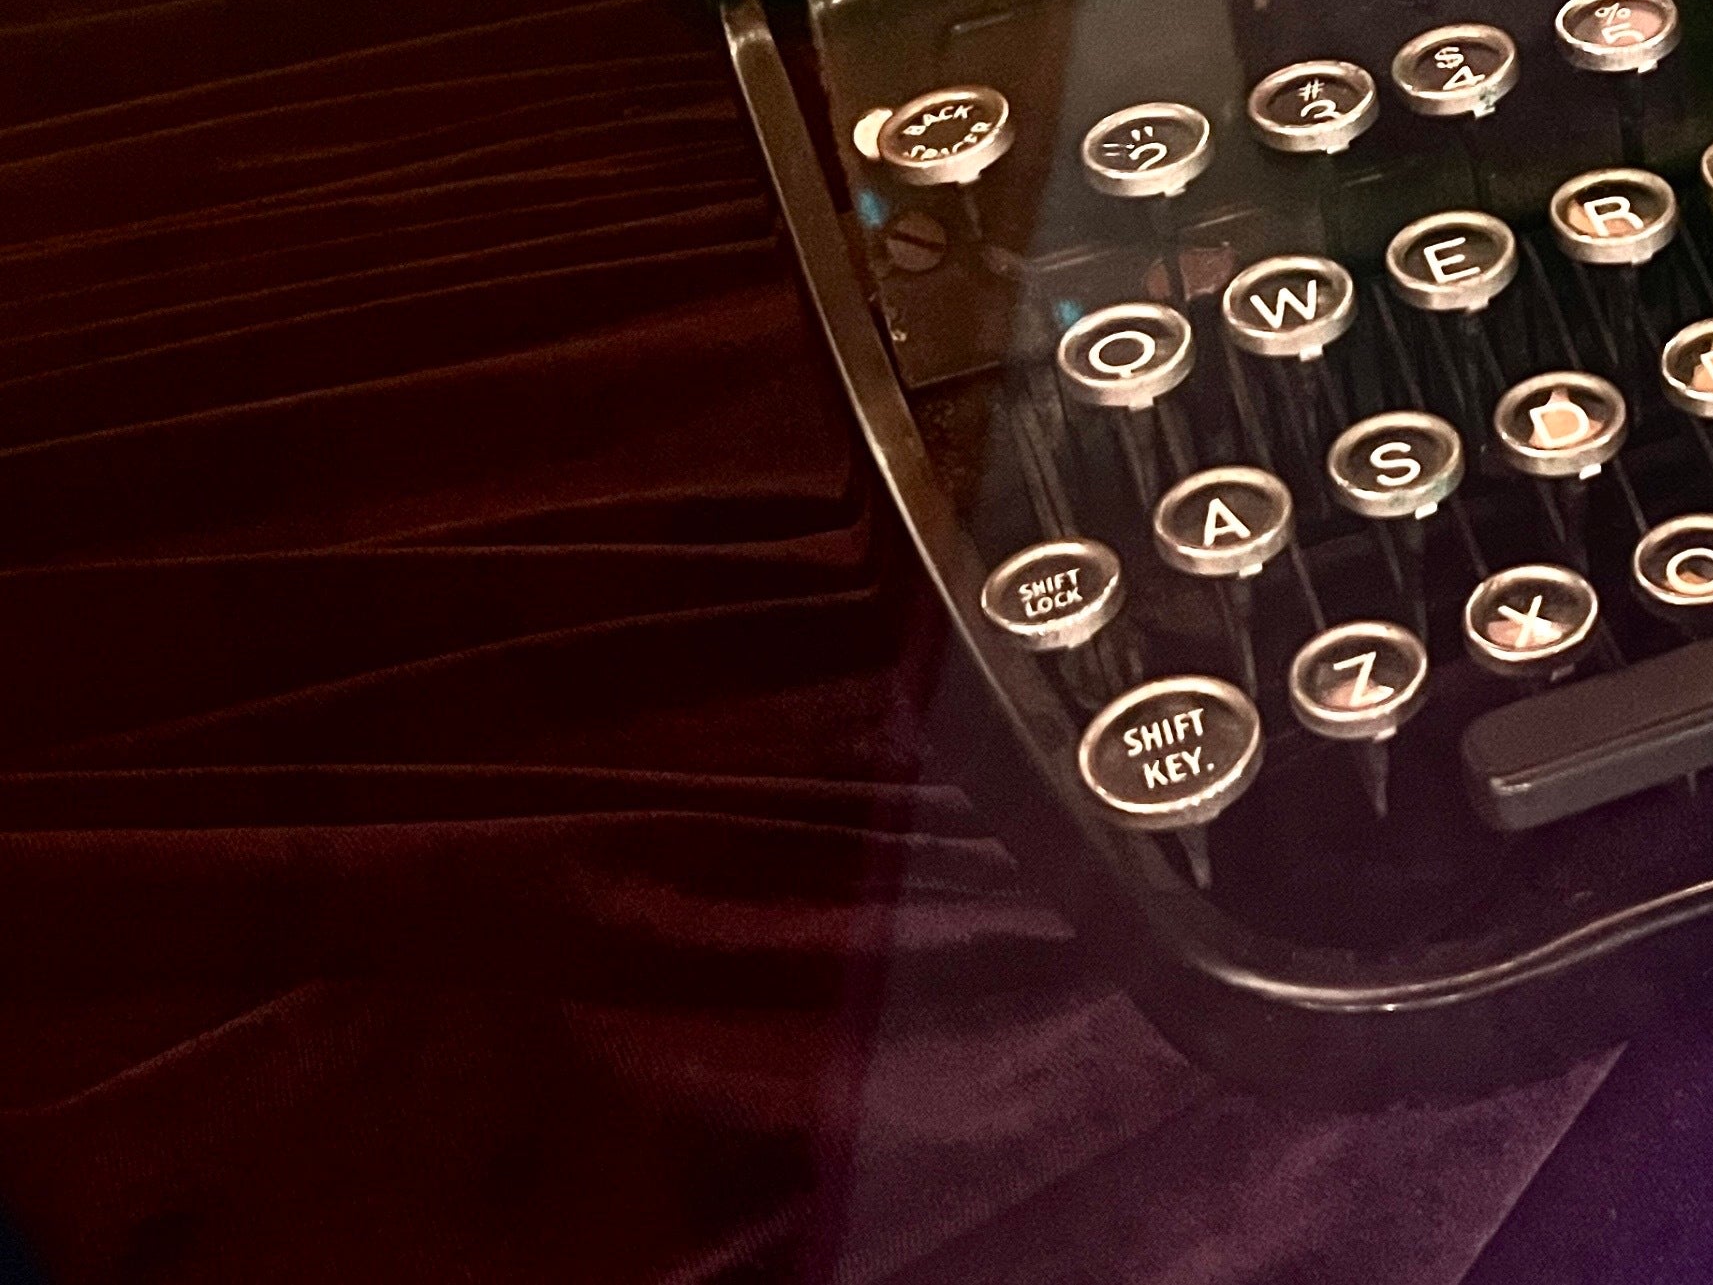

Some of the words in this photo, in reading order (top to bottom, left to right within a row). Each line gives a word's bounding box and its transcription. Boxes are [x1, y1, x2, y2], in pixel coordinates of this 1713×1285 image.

[1594, 2, 1632, 27] %
[1296, 79, 1325, 101] #
[1128, 142, 1167, 172] 2
[1583, 196, 1644, 237] R
[1423, 237, 1481, 283] E
[1250, 279, 1318, 329] W
[1529, 398, 1590, 450] D
[1368, 441, 1422, 487] S
[1203, 497, 1251, 548] A
[1018, 567, 1081, 602] SHIFT
[1024, 588, 1084, 618] LOCK
[1497, 594, 1561, 648] X
[1332, 650, 1395, 708] Z
[1122, 707, 1206, 757] SHIFT
[1142, 745, 1215, 790] KEY.
